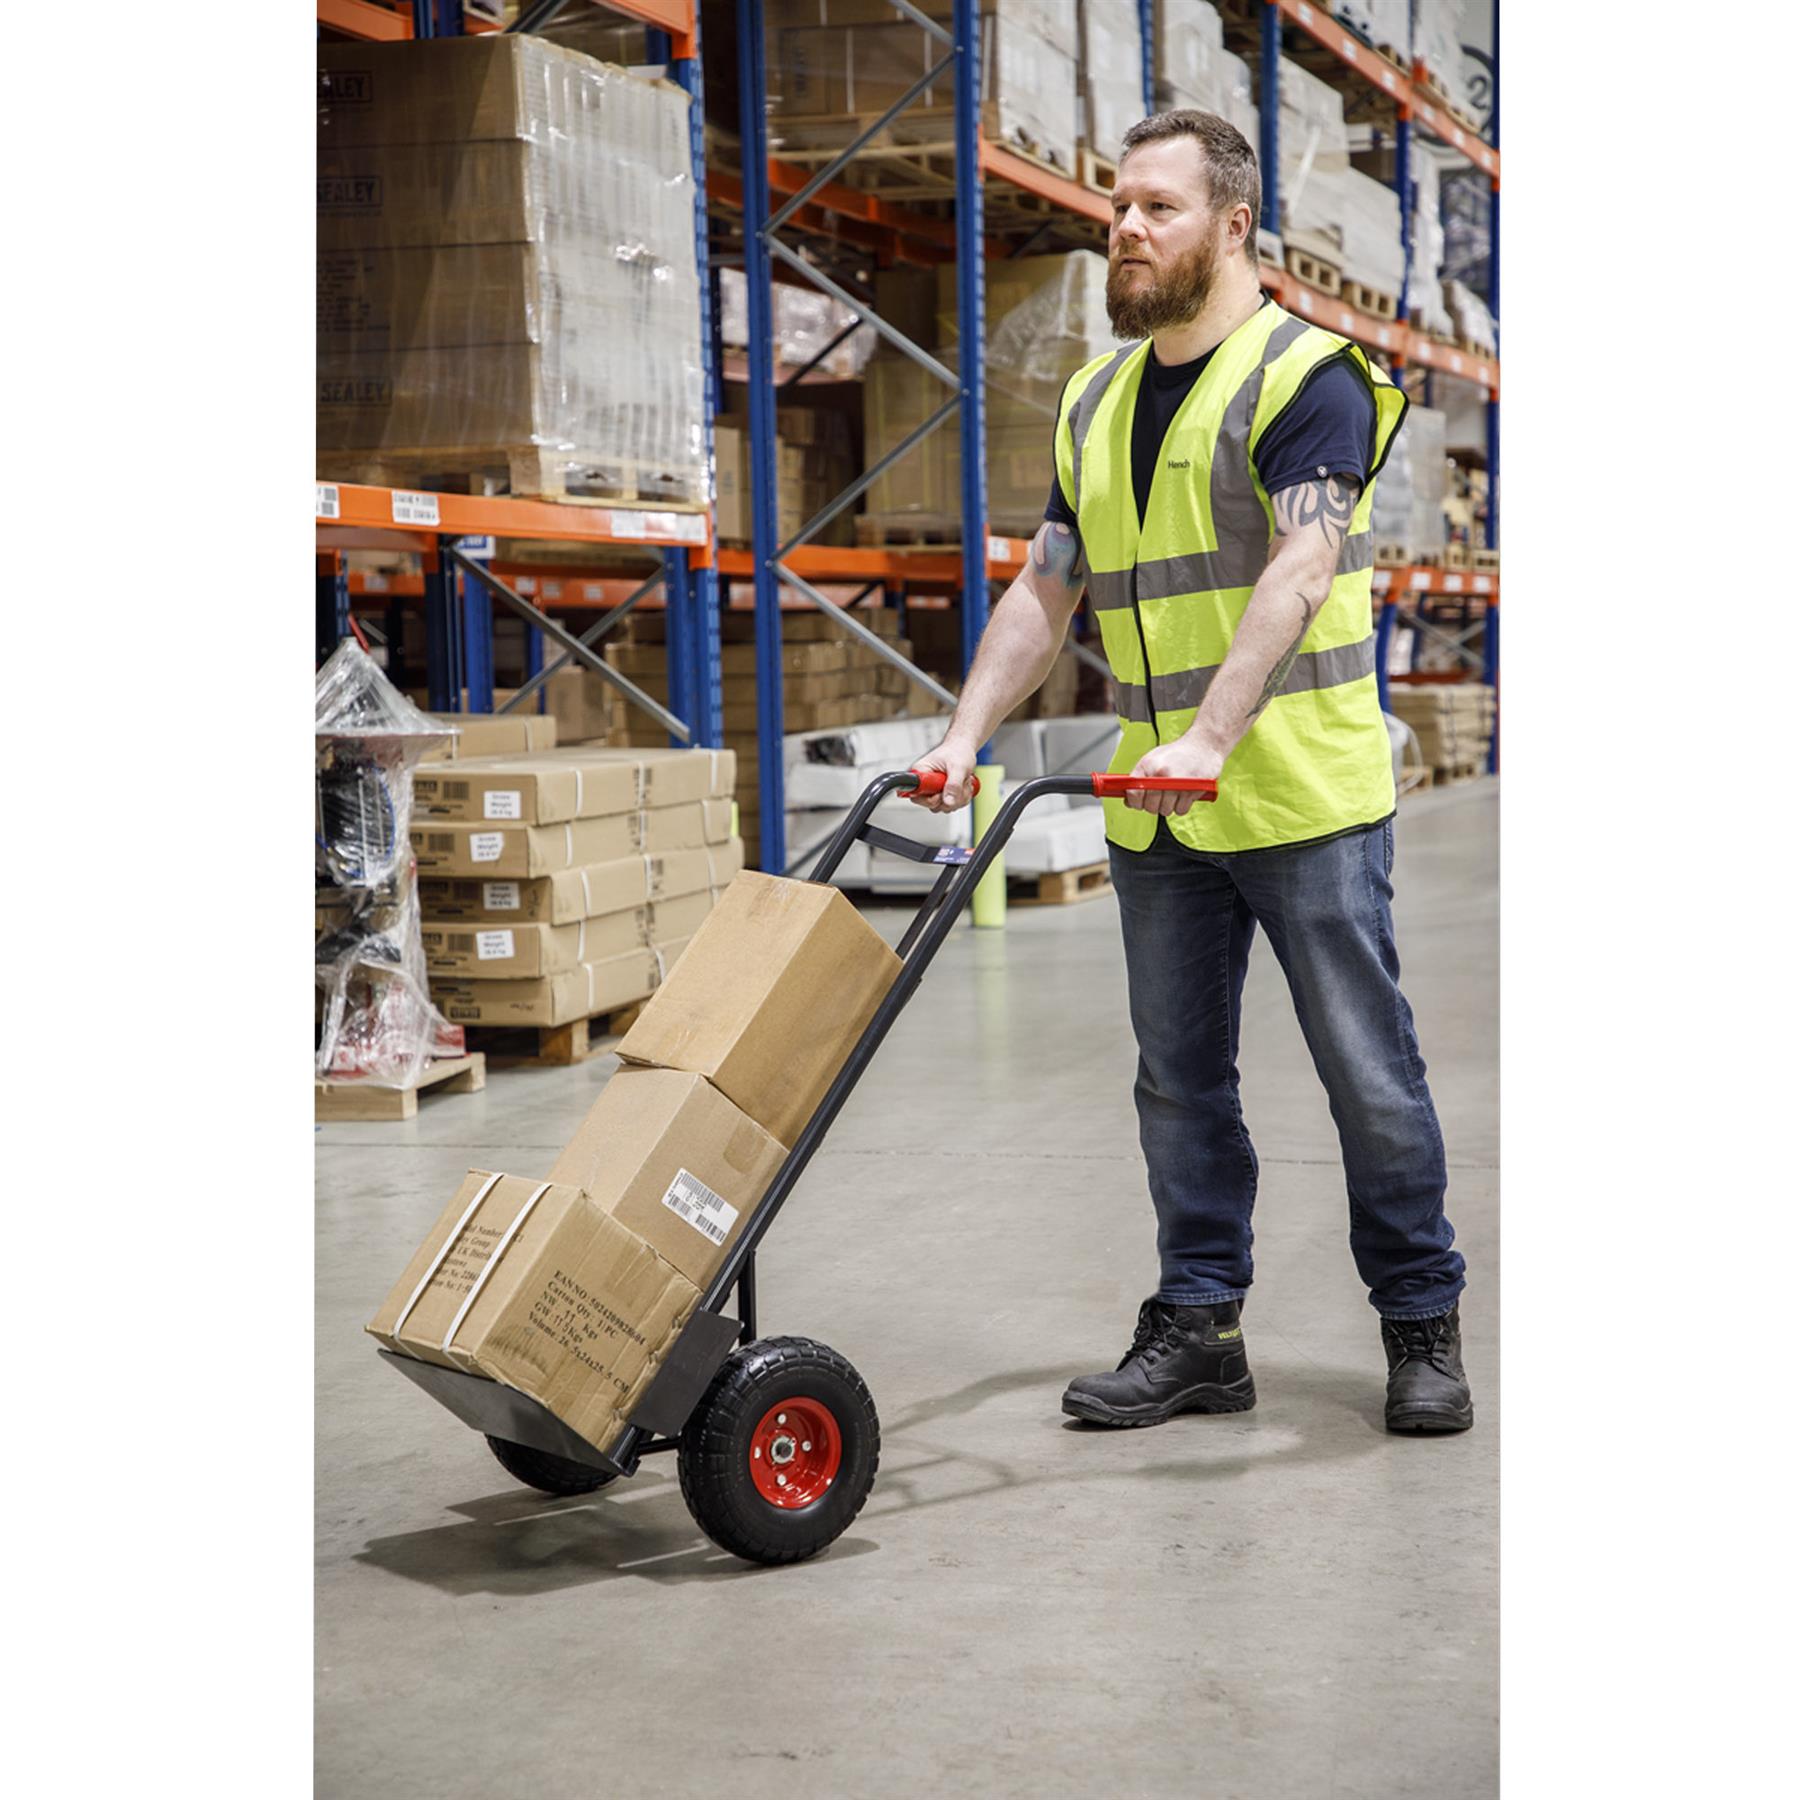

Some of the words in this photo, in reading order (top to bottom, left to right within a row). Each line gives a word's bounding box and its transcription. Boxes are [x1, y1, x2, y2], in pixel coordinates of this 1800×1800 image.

[1467, 75, 1488, 110] 2
[320, 382, 385, 402] SEALEY
[1168, 459, 1190, 469] Hench
[548, 1281, 575, 1306] Carton
